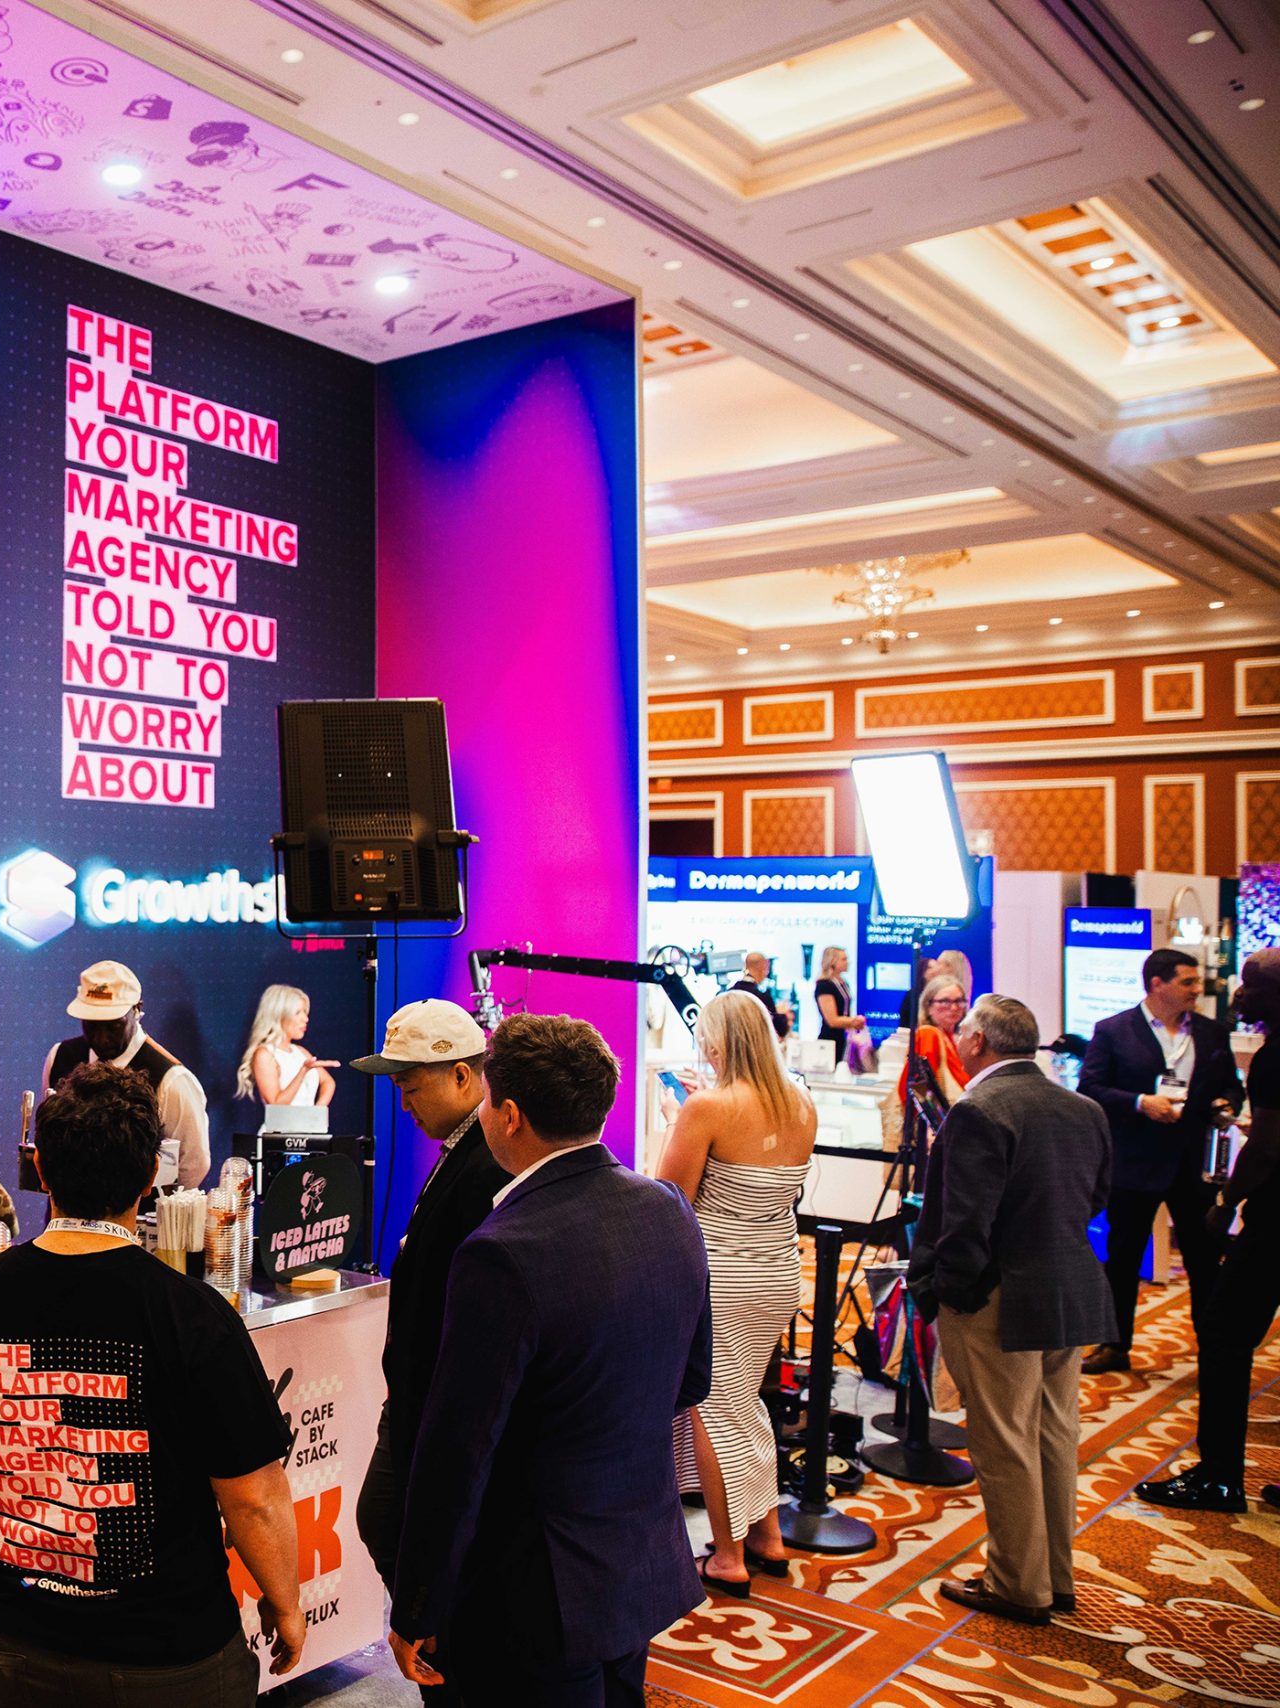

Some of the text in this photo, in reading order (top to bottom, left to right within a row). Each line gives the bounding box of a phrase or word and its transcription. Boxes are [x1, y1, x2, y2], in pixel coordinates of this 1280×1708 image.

[69, 307, 151, 372] THE
[69, 361, 277, 460] PLATFORM
[69, 417, 186, 485] YOUR
[67, 473, 296, 563] MARKETING
[67, 529, 233, 599] AGENCY
[66, 584, 275, 658] TOLD YOU
[66, 640, 226, 701] NOT TO
[65, 697, 218, 753] WORRY
[65, 754, 212, 805] ABOUT
[689, 870, 861, 894] Dermapenworld
[1071, 919, 1144, 936] Dermapenworld
[285, 1138, 307, 1149] GVM
[271, 1214, 351, 1252] ICED LATTES
[275, 1236, 345, 1272] & MATCHA
[300, 1402, 335, 1427] CAFE
[309, 1424, 326, 1442] BY
[296, 1440, 339, 1468] STACK
[72, 1483, 135, 1507] YOU
[61, 1509, 96, 1535] TO
[37, 1577, 119, 1599] Growthstack
[305, 1597, 340, 1629] FLUX
